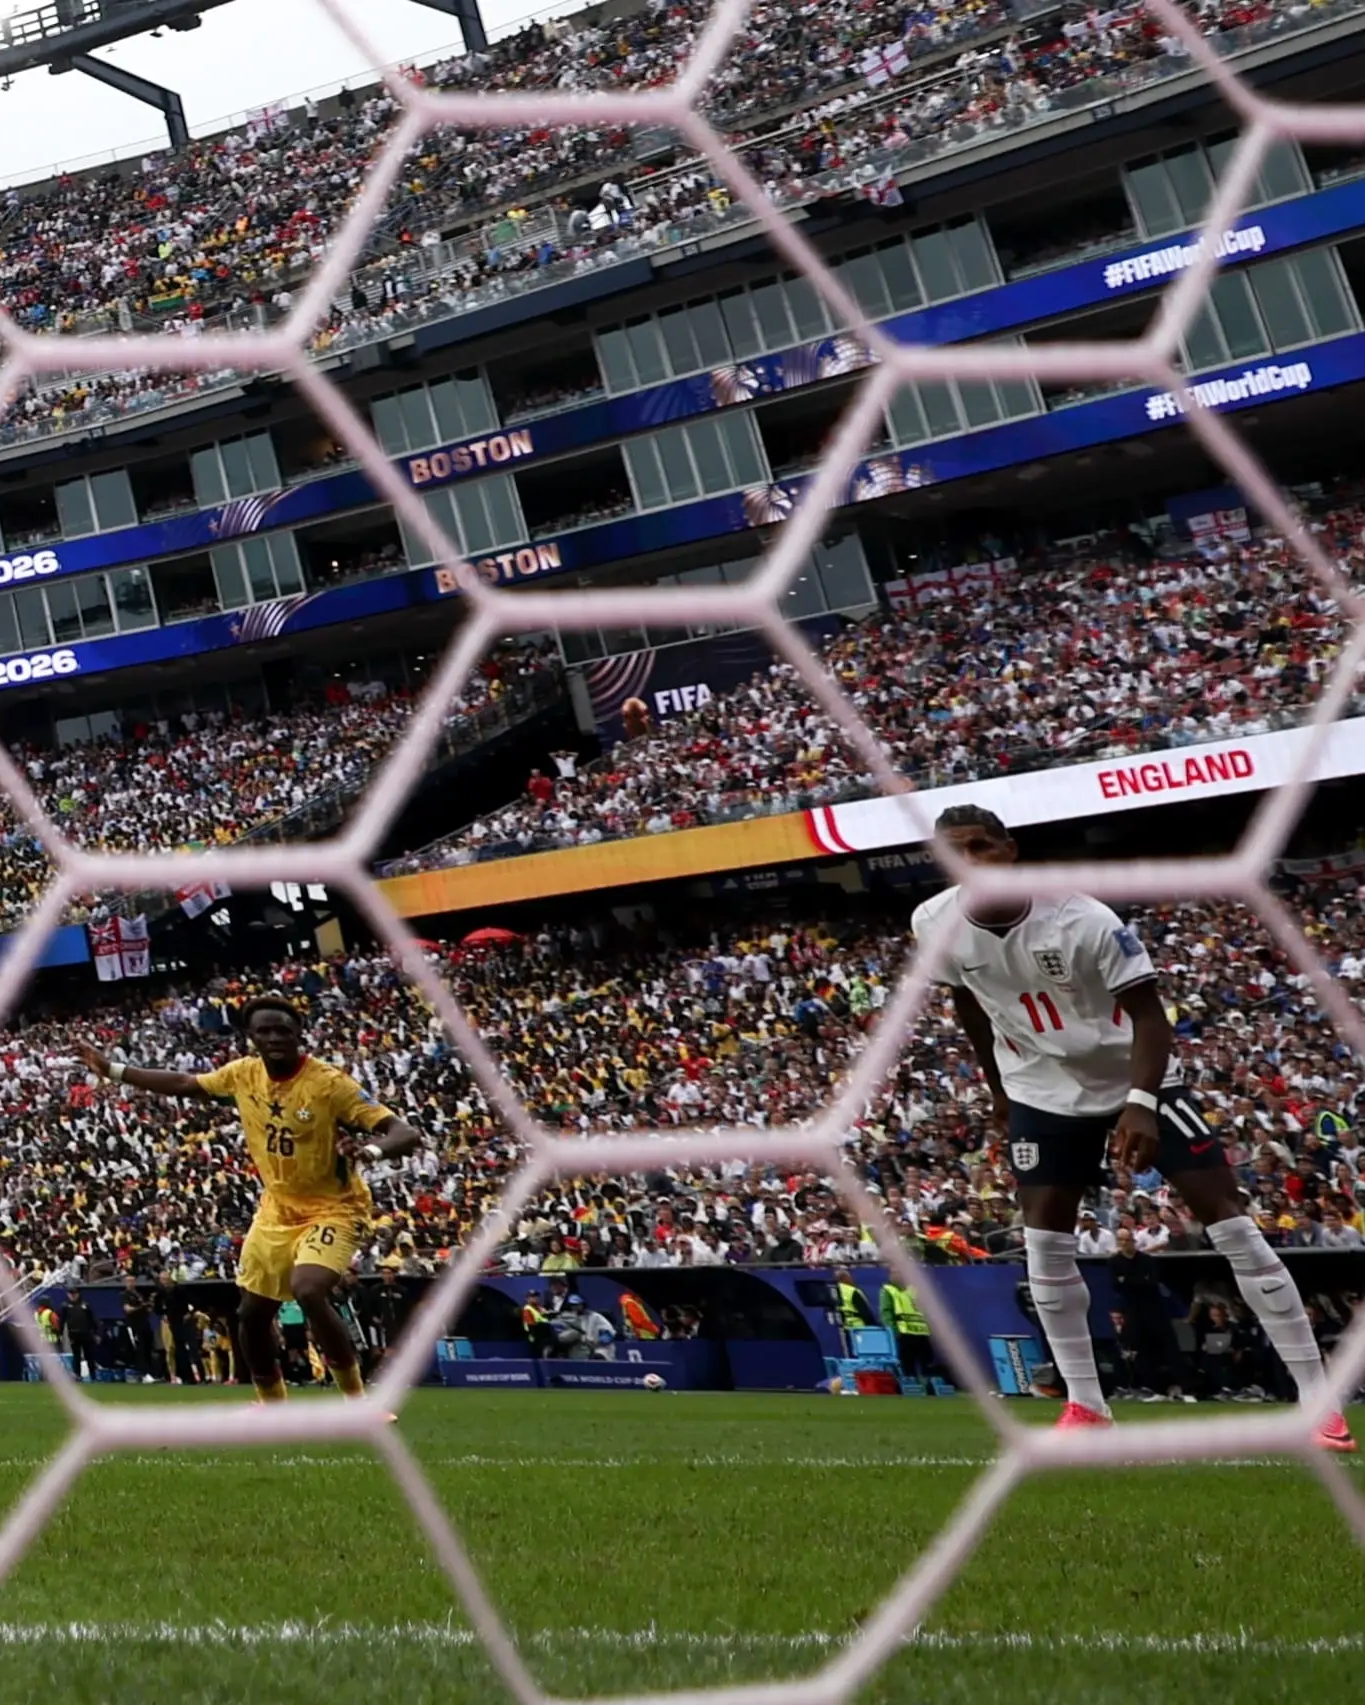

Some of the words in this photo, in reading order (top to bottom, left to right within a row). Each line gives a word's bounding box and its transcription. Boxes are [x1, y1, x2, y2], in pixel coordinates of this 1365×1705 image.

[409, 429, 534, 484] BOSTON
[654, 683, 712, 714] FIFA
[1098, 750, 1255, 799] ENGLAND
[867, 854, 907, 871] FIFA
[1019, 991, 1064, 1033] 11
[1160, 1098, 1211, 1138] 11
[265, 1123, 295, 1157] 26
[305, 1224, 336, 1246] 26
